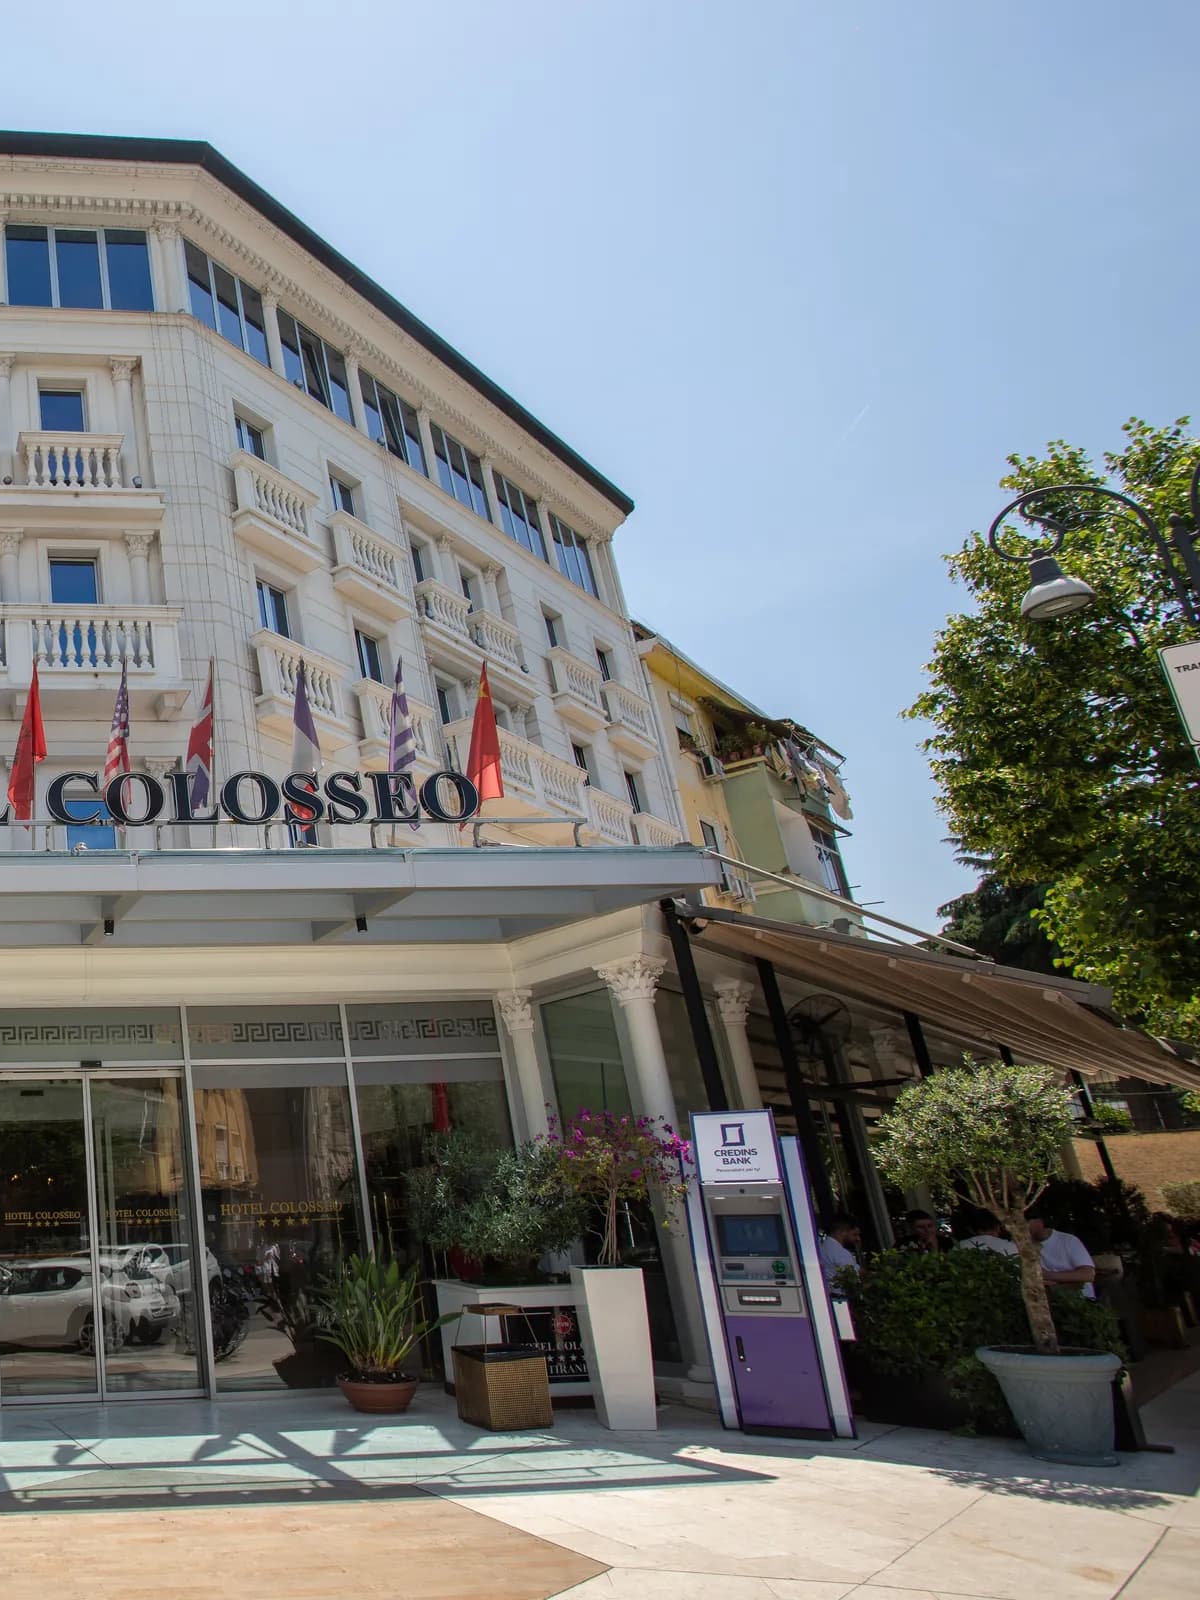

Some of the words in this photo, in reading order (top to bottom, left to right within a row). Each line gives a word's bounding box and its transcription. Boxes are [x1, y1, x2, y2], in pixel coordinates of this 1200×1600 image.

[46, 770, 480, 826] COLOSSEO
[714, 1149, 757, 1157] CREDINS
[4, 1211, 34, 1221] HOTEL
[34, 1210, 81, 1220] COLOSSEO
[220, 1203, 269, 1216] HOTEL
